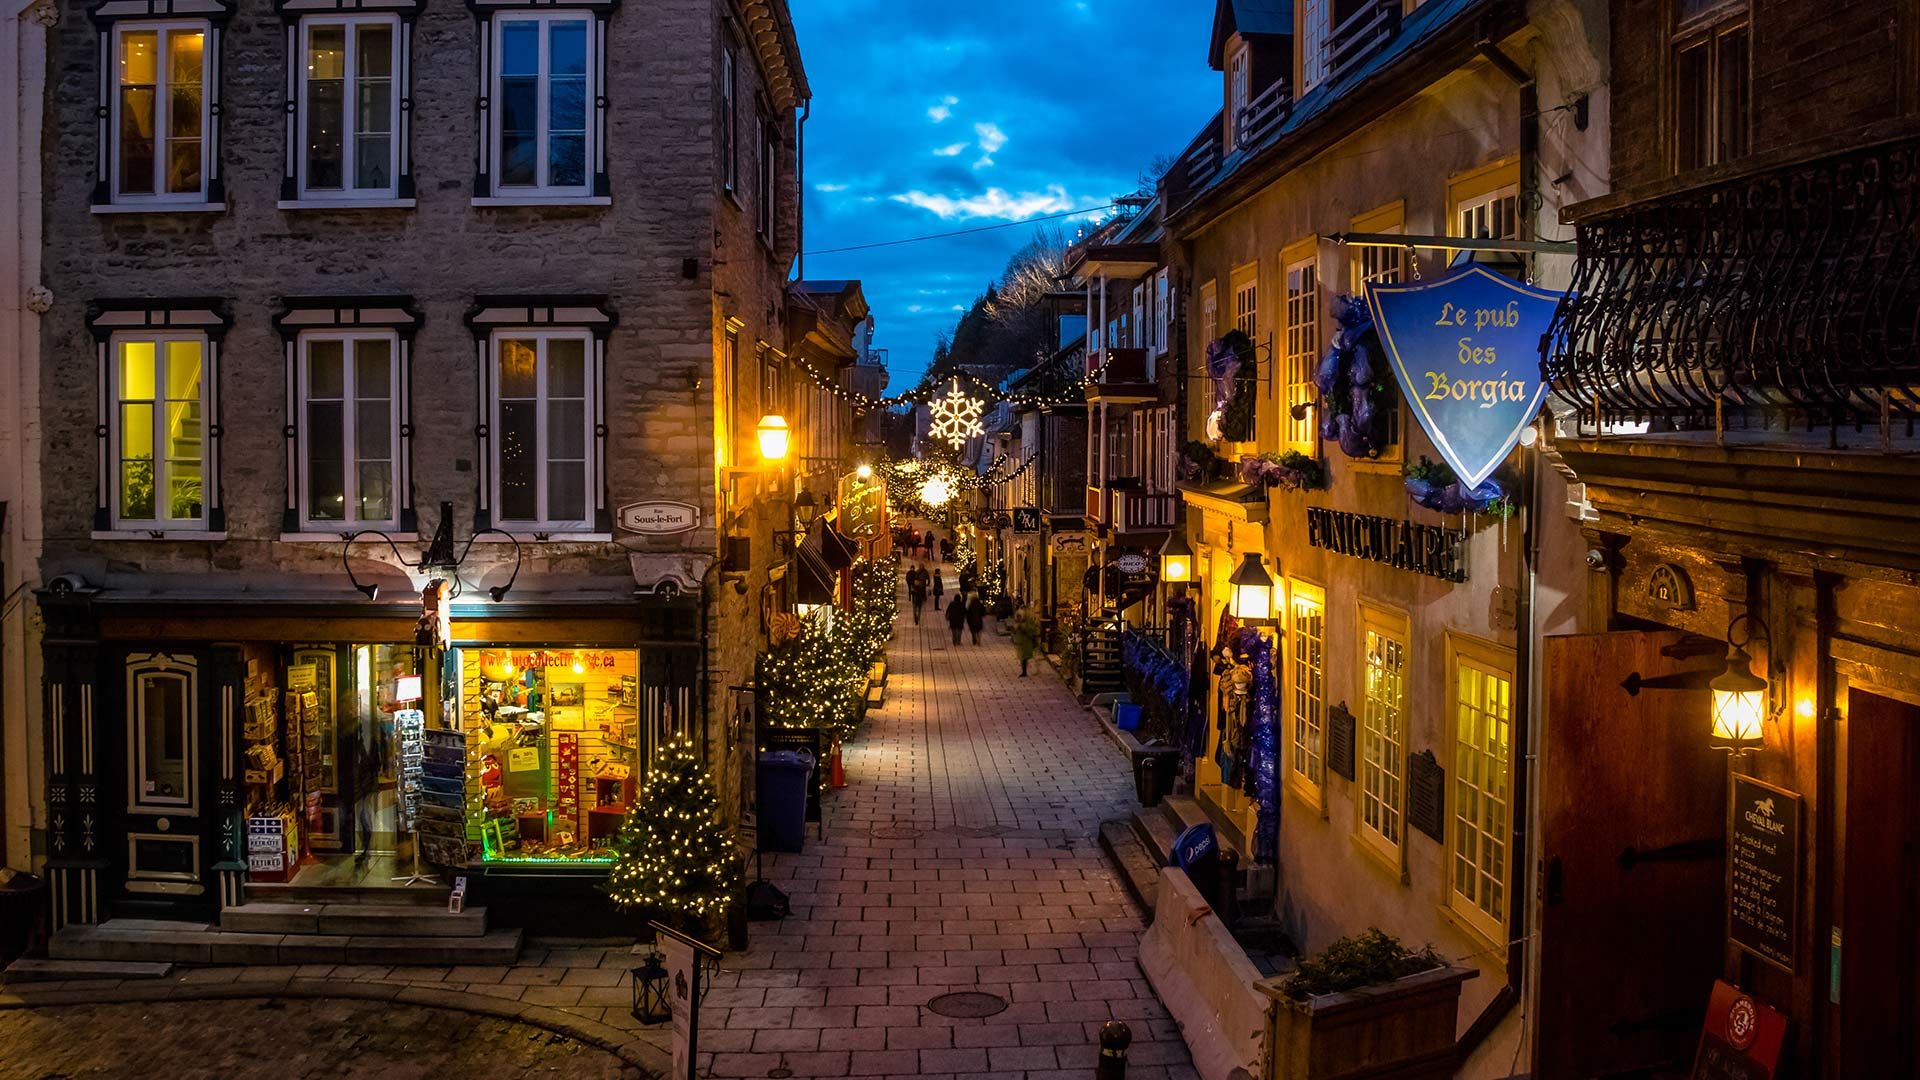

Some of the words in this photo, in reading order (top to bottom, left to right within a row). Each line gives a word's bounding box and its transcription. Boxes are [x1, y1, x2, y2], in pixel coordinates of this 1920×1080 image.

[1435, 302, 1467, 326] Le
[1474, 300, 1519, 332] pub
[1457, 337, 1496, 364] des
[1425, 370, 1526, 408] Borgia
[634, 514, 683, 524] Sous-le-Fort
[1307, 506, 1471, 583] FUNICULAIRE
[1659, 587, 1668, 600] 12
[1744, 810, 1766, 828] CHEVAL
[1766, 818, 1785, 835] BLANC
